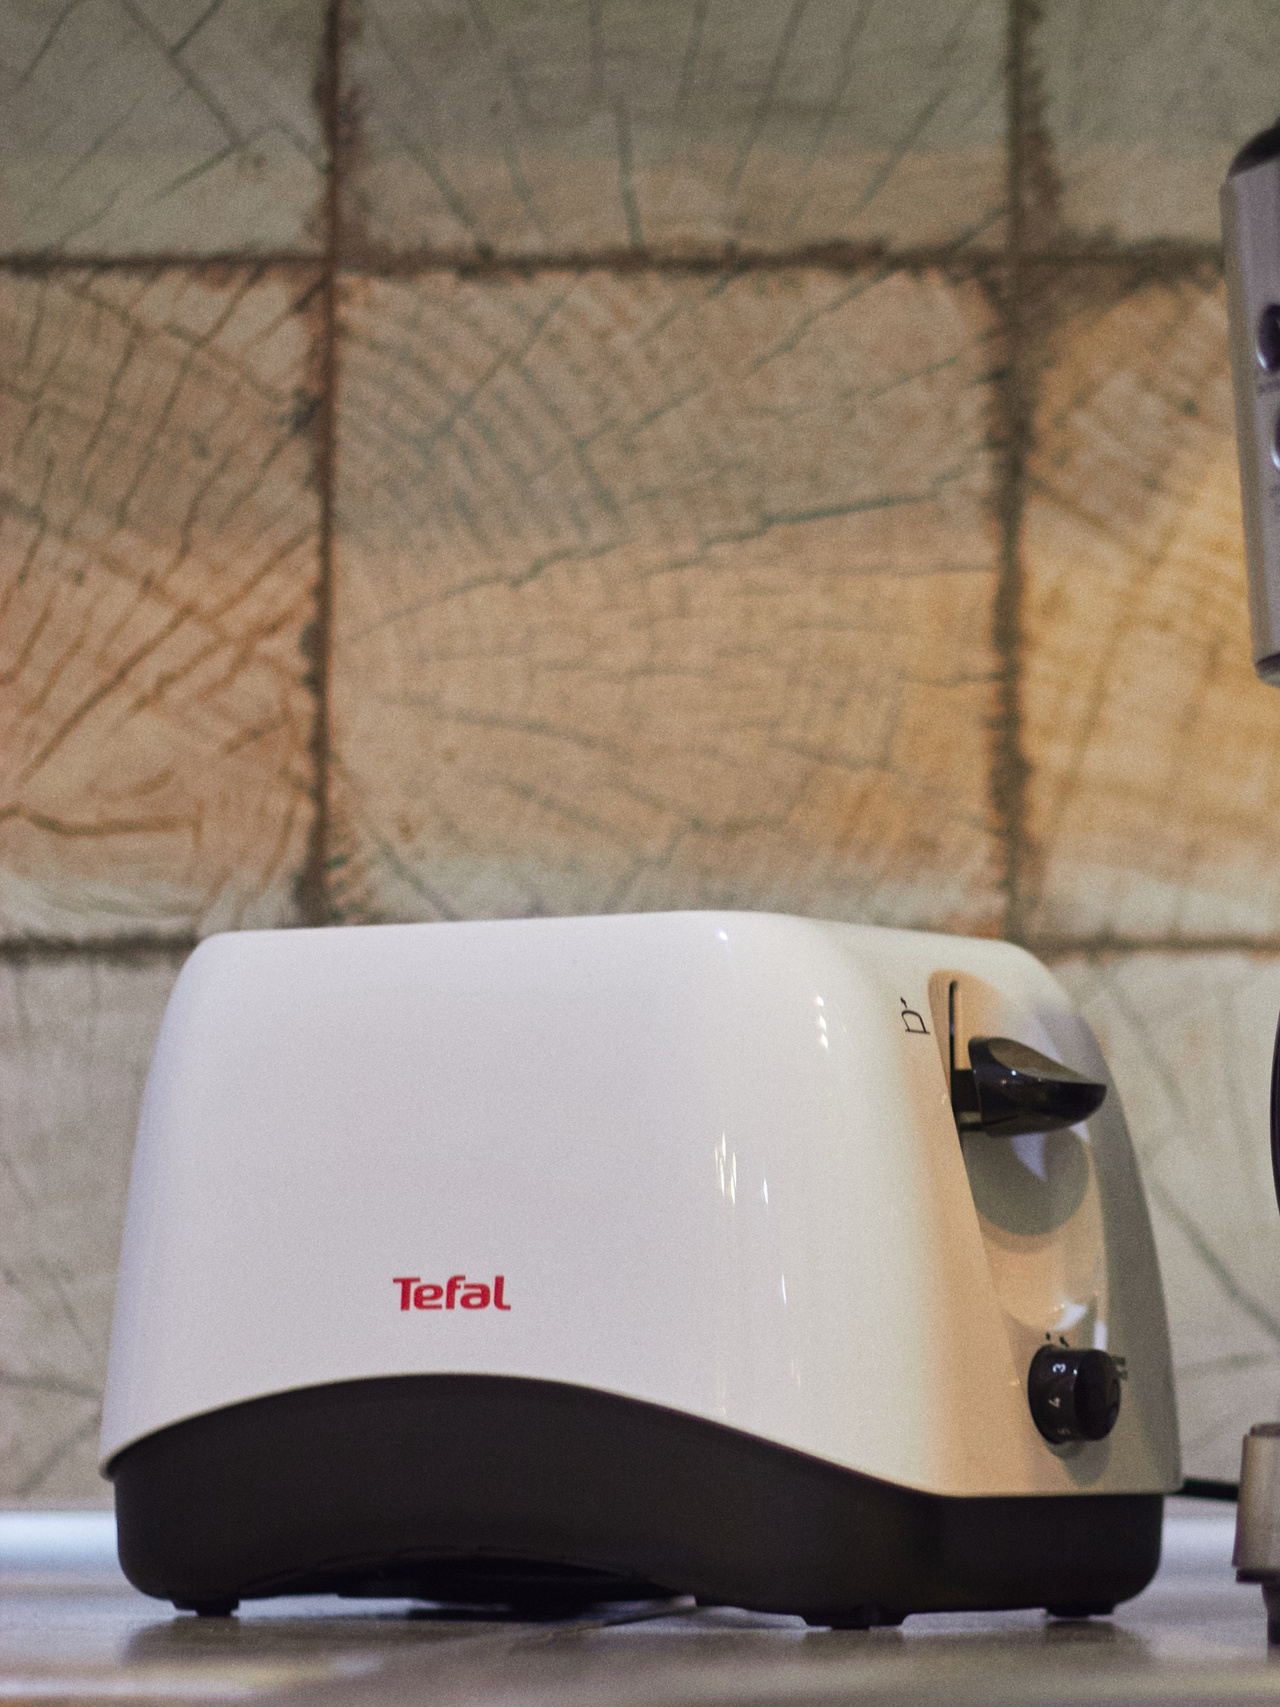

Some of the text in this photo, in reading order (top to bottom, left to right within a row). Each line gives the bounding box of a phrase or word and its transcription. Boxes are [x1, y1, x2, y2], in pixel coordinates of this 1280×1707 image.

[393, 1275, 511, 1310] Tefal
[1053, 1363, 1066, 1373] 3
[1049, 1397, 1060, 1408] 4
